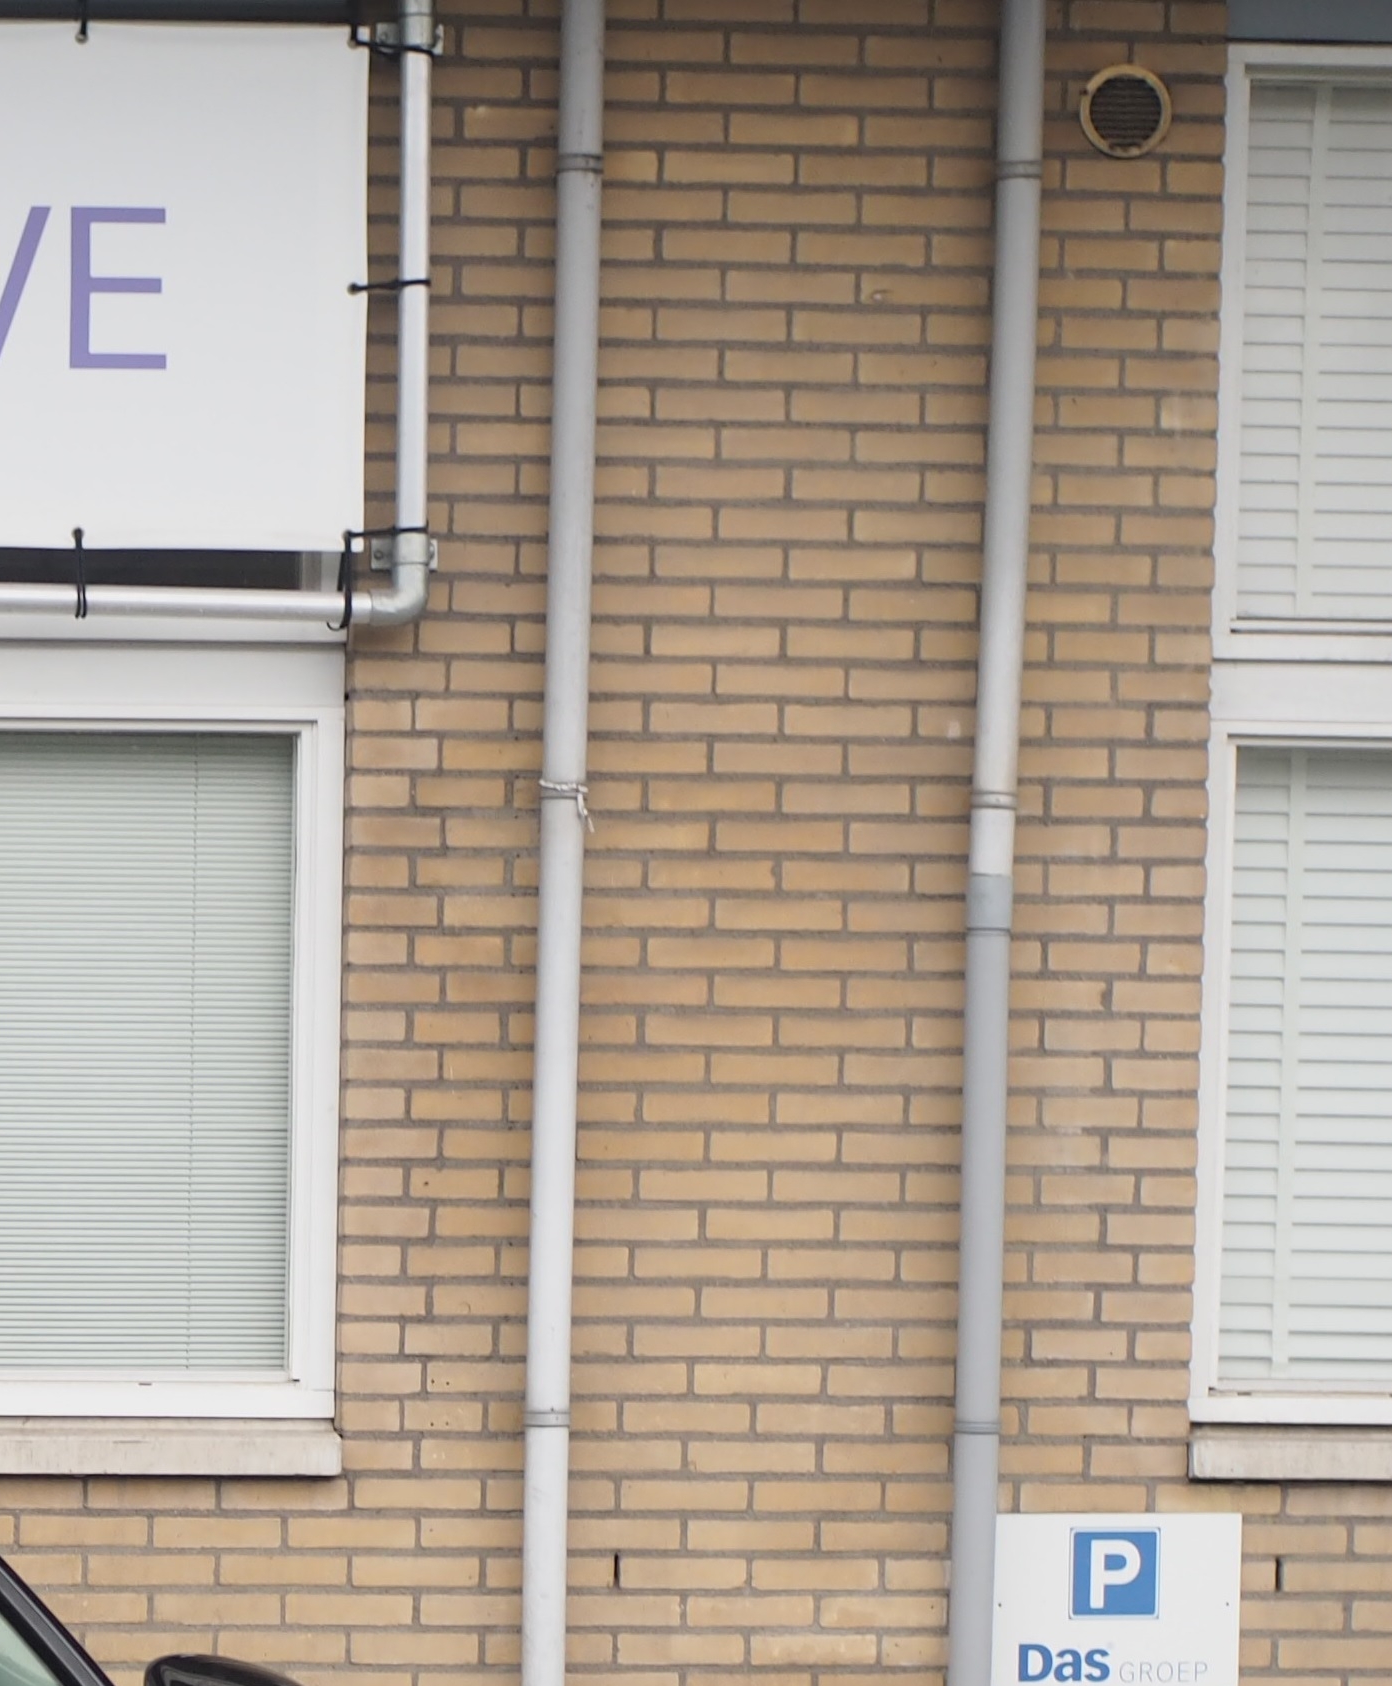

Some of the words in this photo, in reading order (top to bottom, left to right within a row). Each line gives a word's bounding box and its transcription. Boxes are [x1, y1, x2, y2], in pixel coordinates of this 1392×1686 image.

[1089, 1539, 1142, 1609] P
[1017, 1643, 1111, 1683] Das
[1118, 1660, 1209, 1684] GROEP
